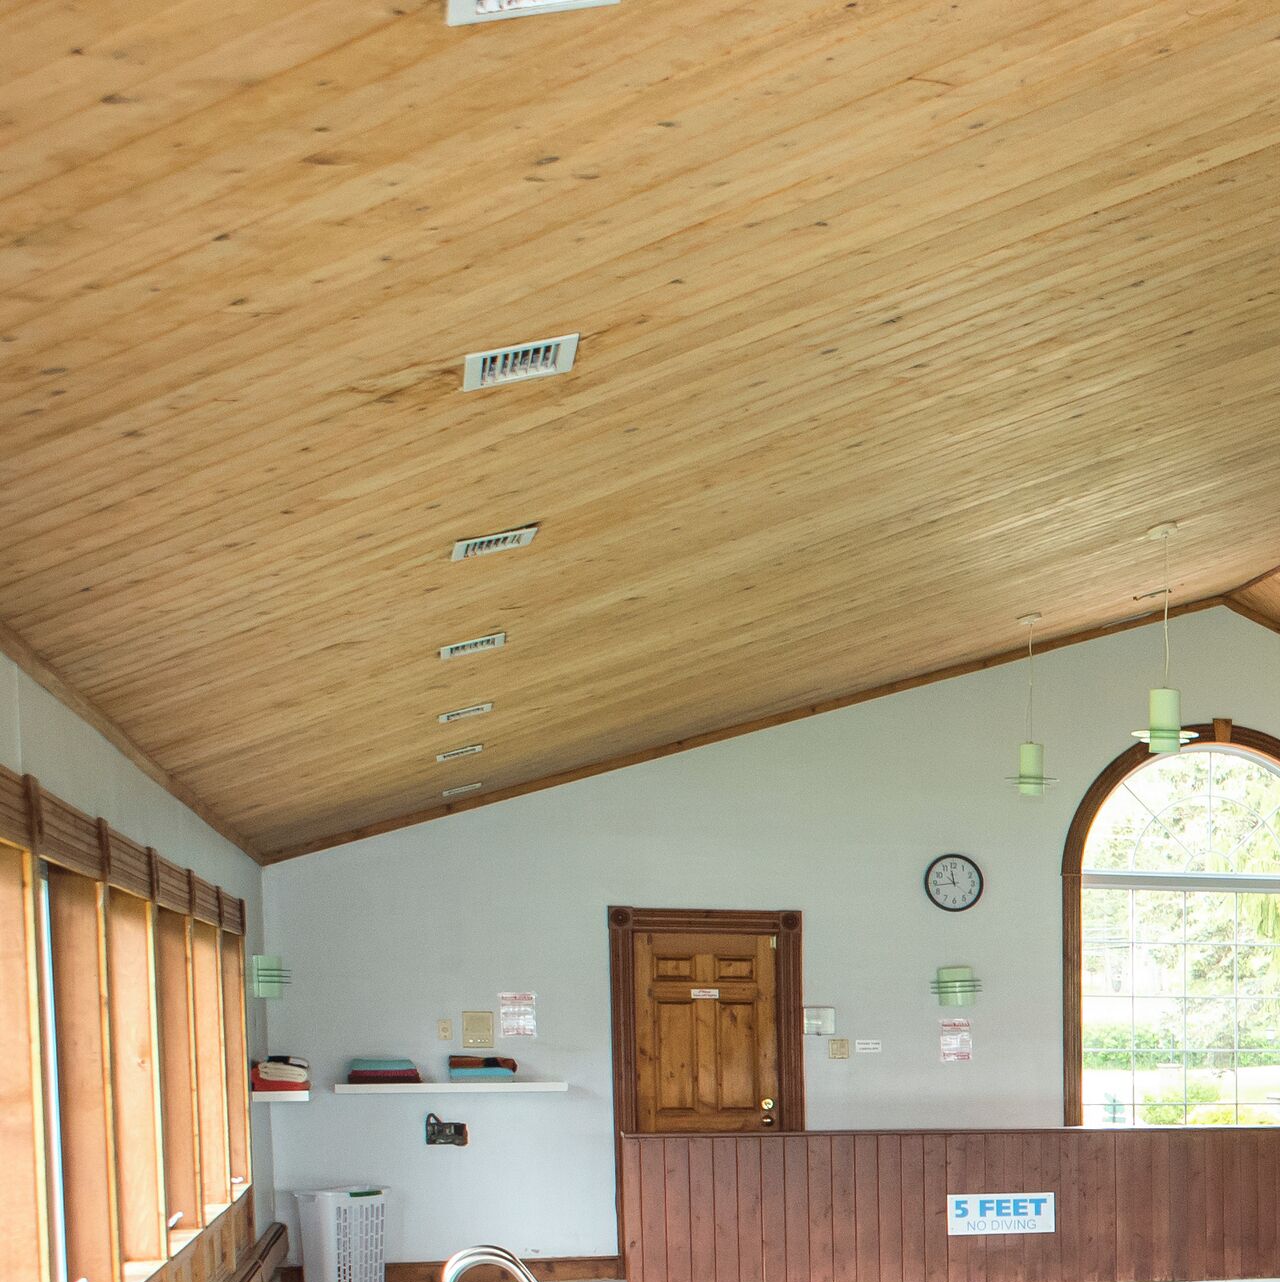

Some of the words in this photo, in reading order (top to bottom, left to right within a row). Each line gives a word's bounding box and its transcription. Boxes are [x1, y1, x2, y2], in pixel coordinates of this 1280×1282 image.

[955, 1200, 968, 1218] 5
[979, 1199, 1047, 1217] FEET
[967, 1221, 987, 1231] NO
[991, 1219, 1037, 1231] DIVING
